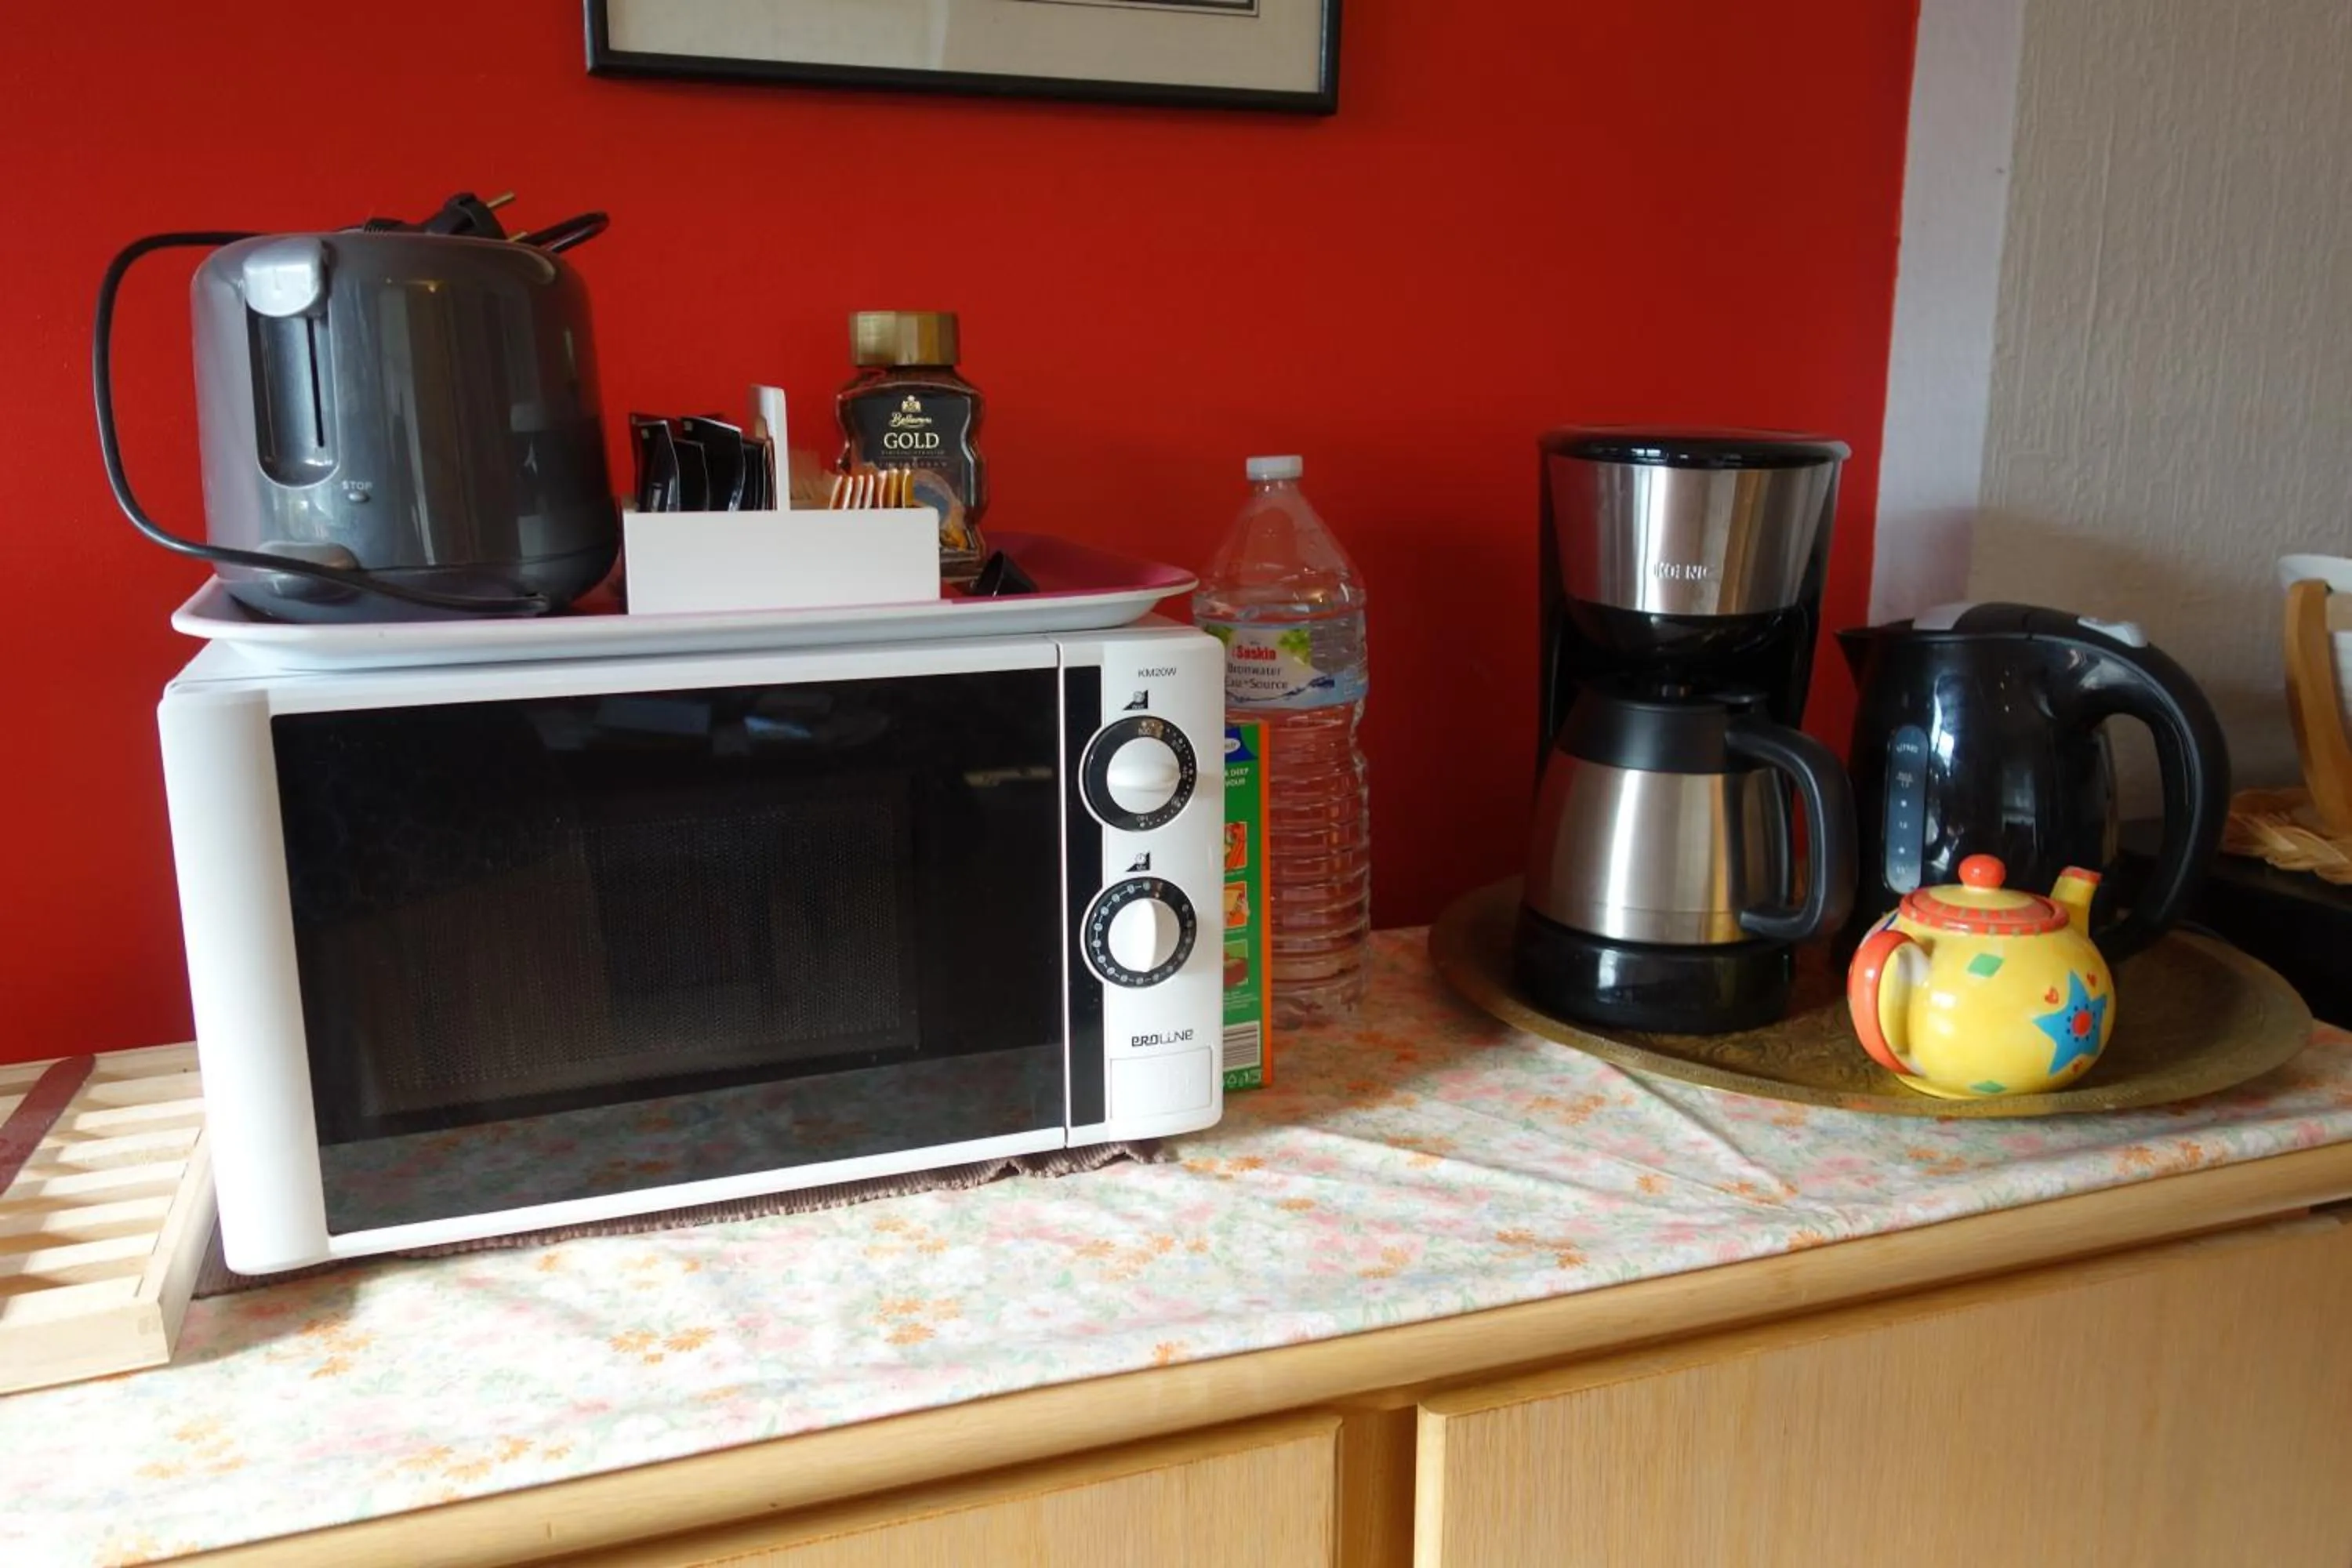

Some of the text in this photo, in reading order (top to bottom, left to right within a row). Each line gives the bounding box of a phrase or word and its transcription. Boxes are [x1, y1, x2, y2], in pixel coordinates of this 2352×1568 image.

[884, 432, 939, 449] GOLD
[343, 481, 372, 490] STOP
[1138, 667, 1177, 677] KM20W
[1249, 677, 1288, 689] Source
[1131, 1029, 1194, 1047] PROLINE
